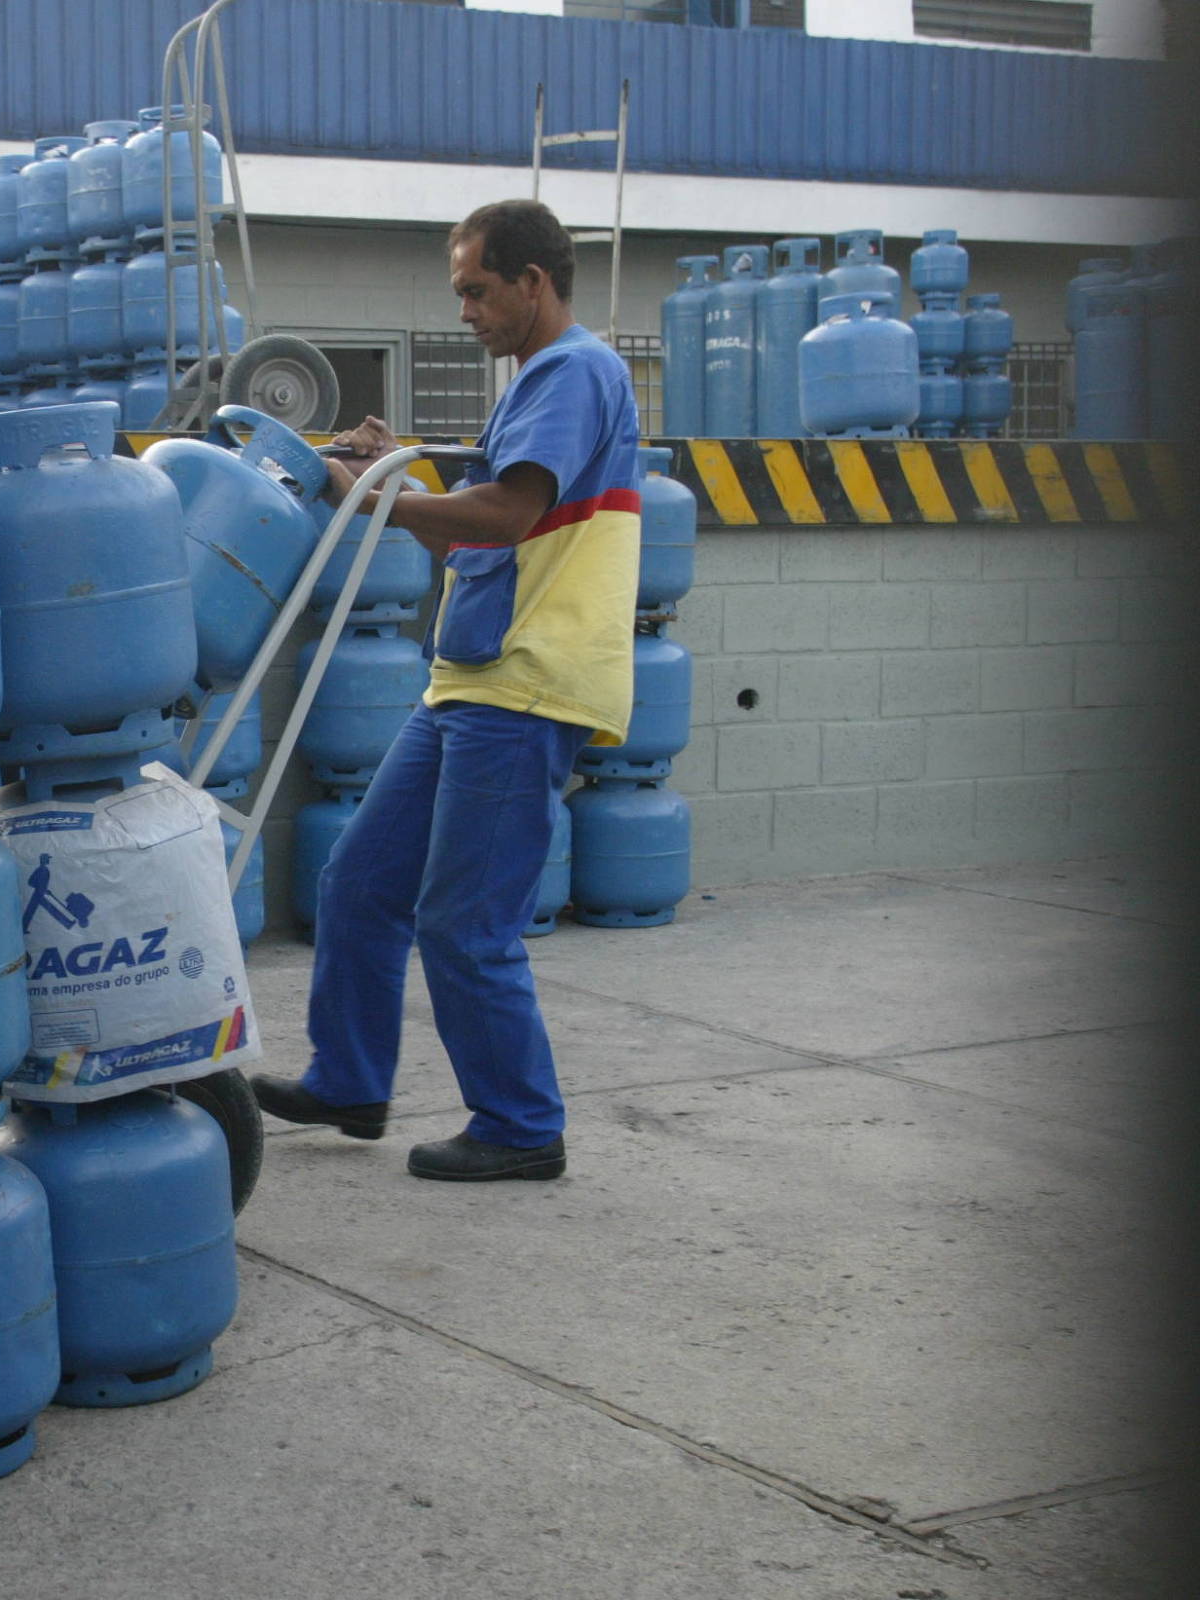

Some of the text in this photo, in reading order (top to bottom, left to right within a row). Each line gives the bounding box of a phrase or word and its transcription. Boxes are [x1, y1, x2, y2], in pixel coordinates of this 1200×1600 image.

[26, 926, 169, 981] AGAZ
[51, 978, 111, 996] empresa
[114, 972, 131, 988] do
[134, 965, 170, 984] grupo
[114, 1040, 193, 1067] ULTRAGAZ
